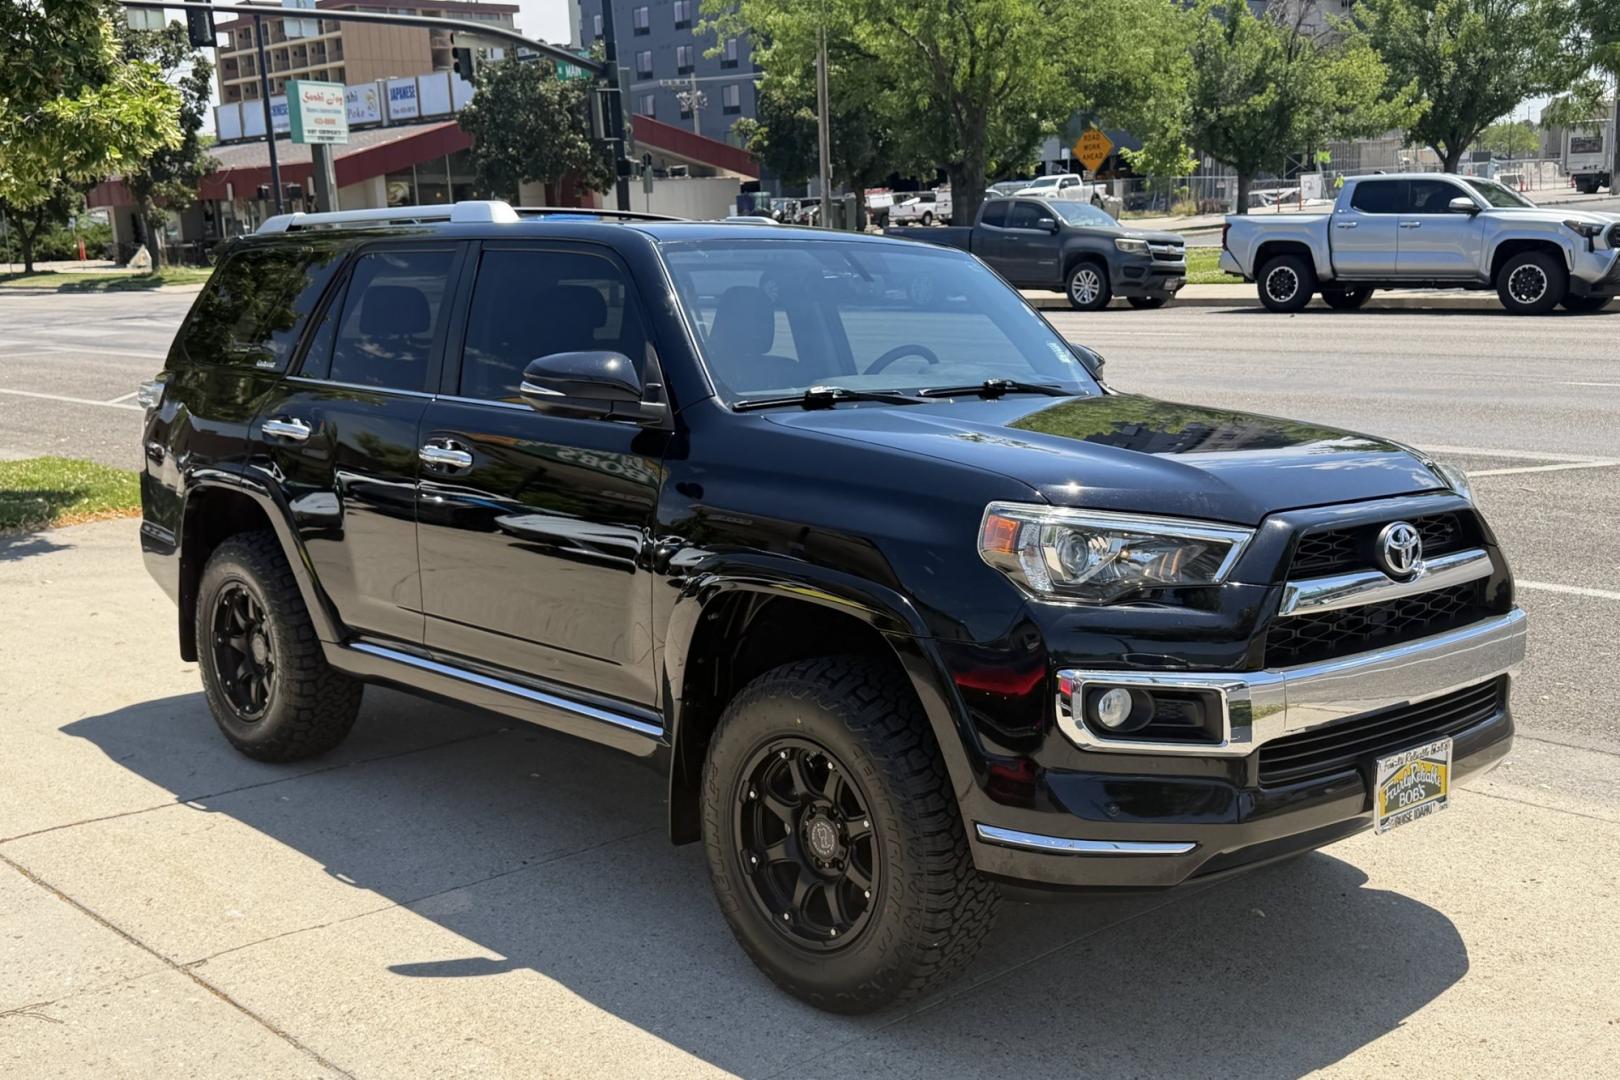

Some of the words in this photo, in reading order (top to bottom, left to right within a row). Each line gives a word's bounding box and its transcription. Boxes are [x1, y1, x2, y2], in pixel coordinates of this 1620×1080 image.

[1083, 133, 1100, 141] ROAD
[1083, 143, 1100, 151] WORK
[1082, 152, 1103, 160] AHEAD
[1399, 784, 1425, 807] BOB'S
